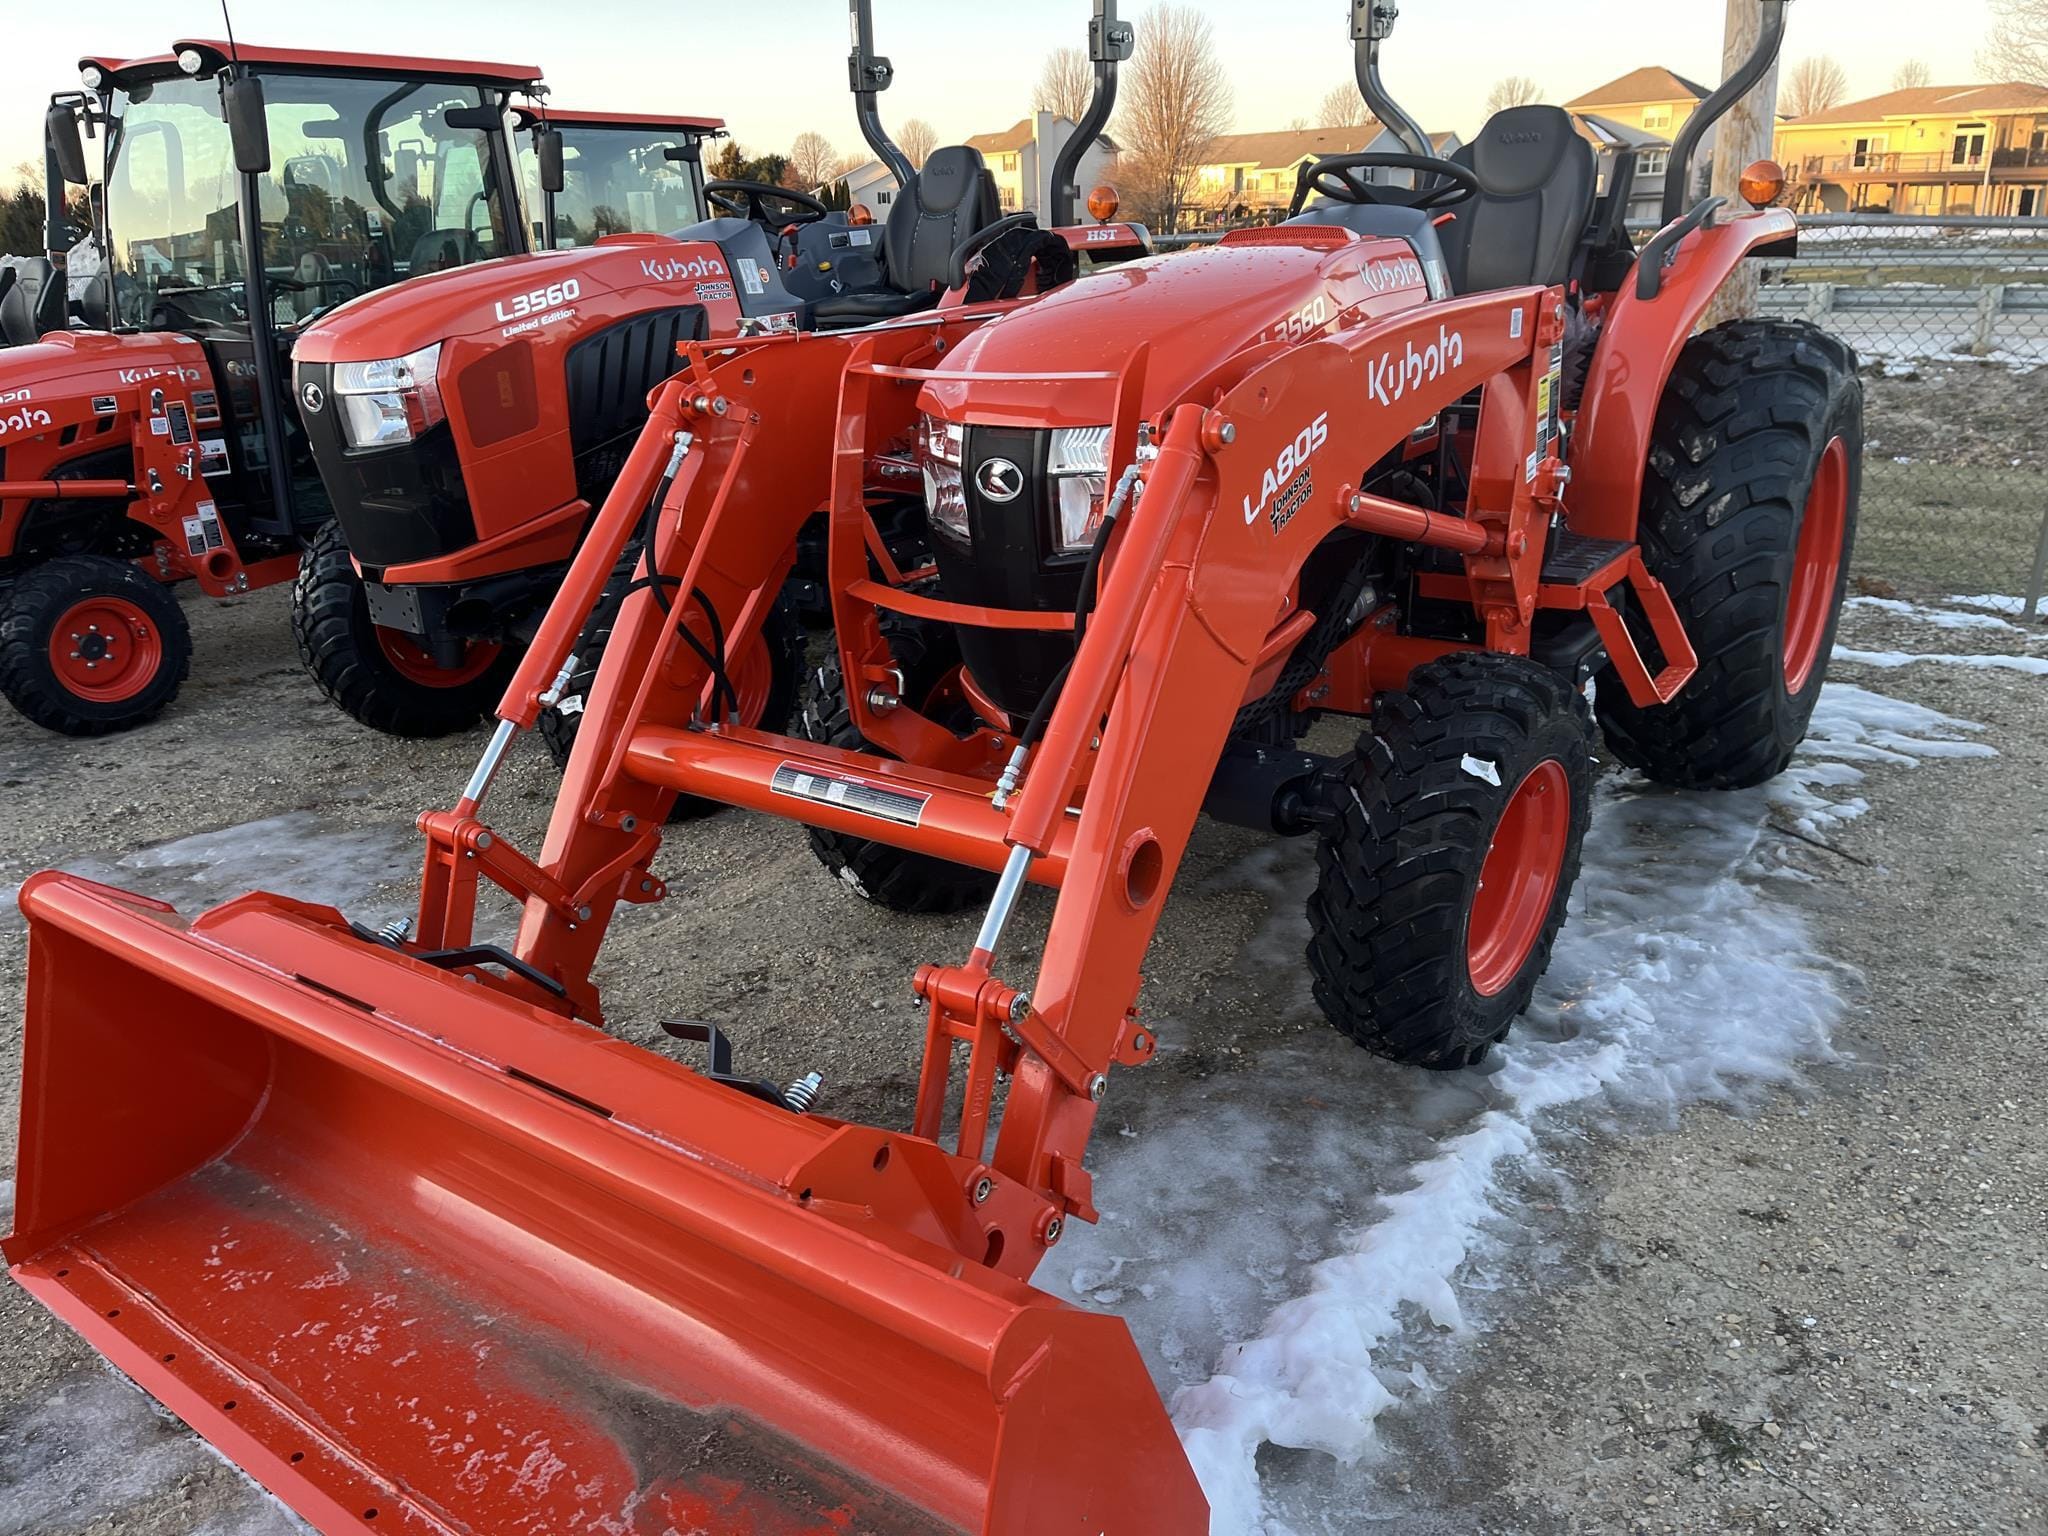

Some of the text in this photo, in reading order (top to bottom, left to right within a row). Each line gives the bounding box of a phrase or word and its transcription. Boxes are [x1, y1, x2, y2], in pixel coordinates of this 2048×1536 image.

[1087, 230, 1117, 240] HST
[640, 256, 724, 280] Kubota
[1357, 257, 1421, 291] Kubota
[495, 279, 580, 321] L3560
[694, 282, 730, 292] JOHNSON
[697, 291, 732, 301] TRACTOR
[503, 309, 576, 337] Limited Edition
[1368, 325, 1463, 406] Kubota
[1243, 411, 1328, 525] LA805
[1270, 465, 1311, 521] JOHNSON
[1272, 482, 1313, 535] TRACTOR
